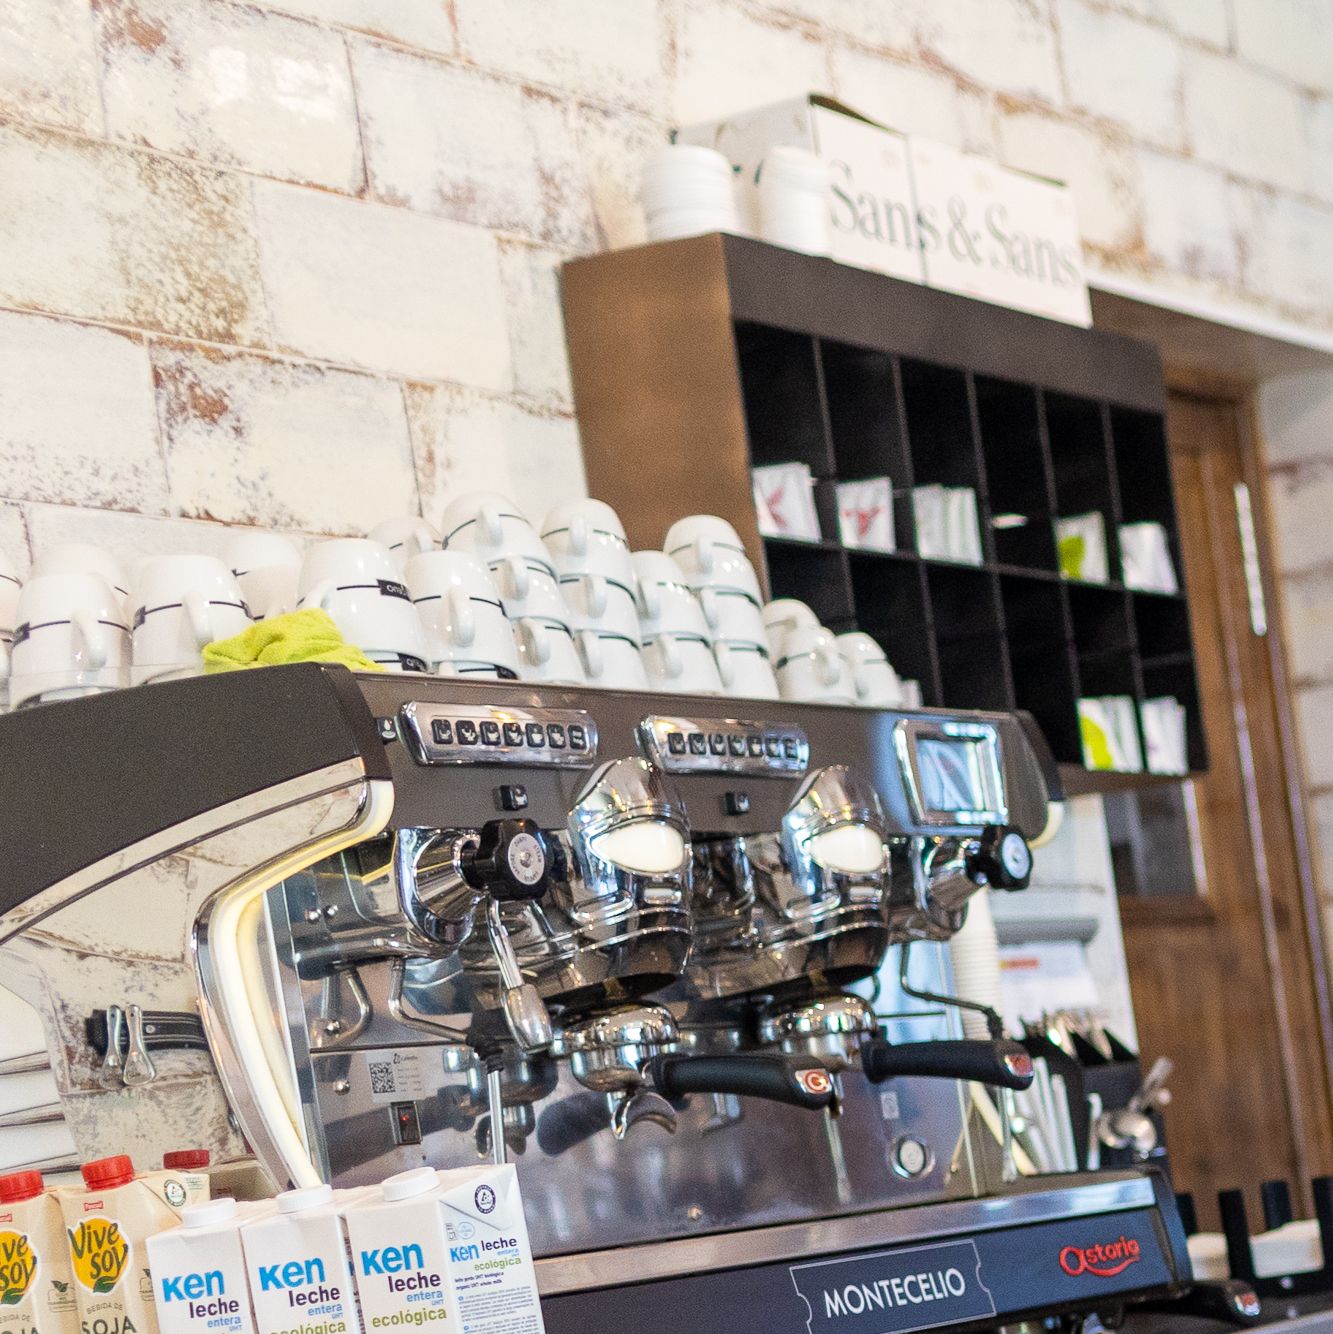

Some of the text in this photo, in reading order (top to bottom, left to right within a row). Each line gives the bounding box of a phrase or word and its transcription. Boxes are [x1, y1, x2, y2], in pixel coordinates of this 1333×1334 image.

[830, 159, 1082, 287] Sans & Sans
[68, 1221, 120, 1259] Vive
[481, 1237, 517, 1252] leche
[90, 1244, 129, 1281] soy
[474, 1256, 522, 1271] ecológica
[388, 1272, 441, 1293] leche
[288, 1285, 341, 1307] leche
[406, 1290, 444, 1303] entera
[823, 1268, 966, 1319] MONTECELIO
[189, 1298, 240, 1319] leche
[308, 1303, 343, 1317] entera
[372, 1308, 447, 1328] ecológica
[207, 1315, 241, 1328] entera
